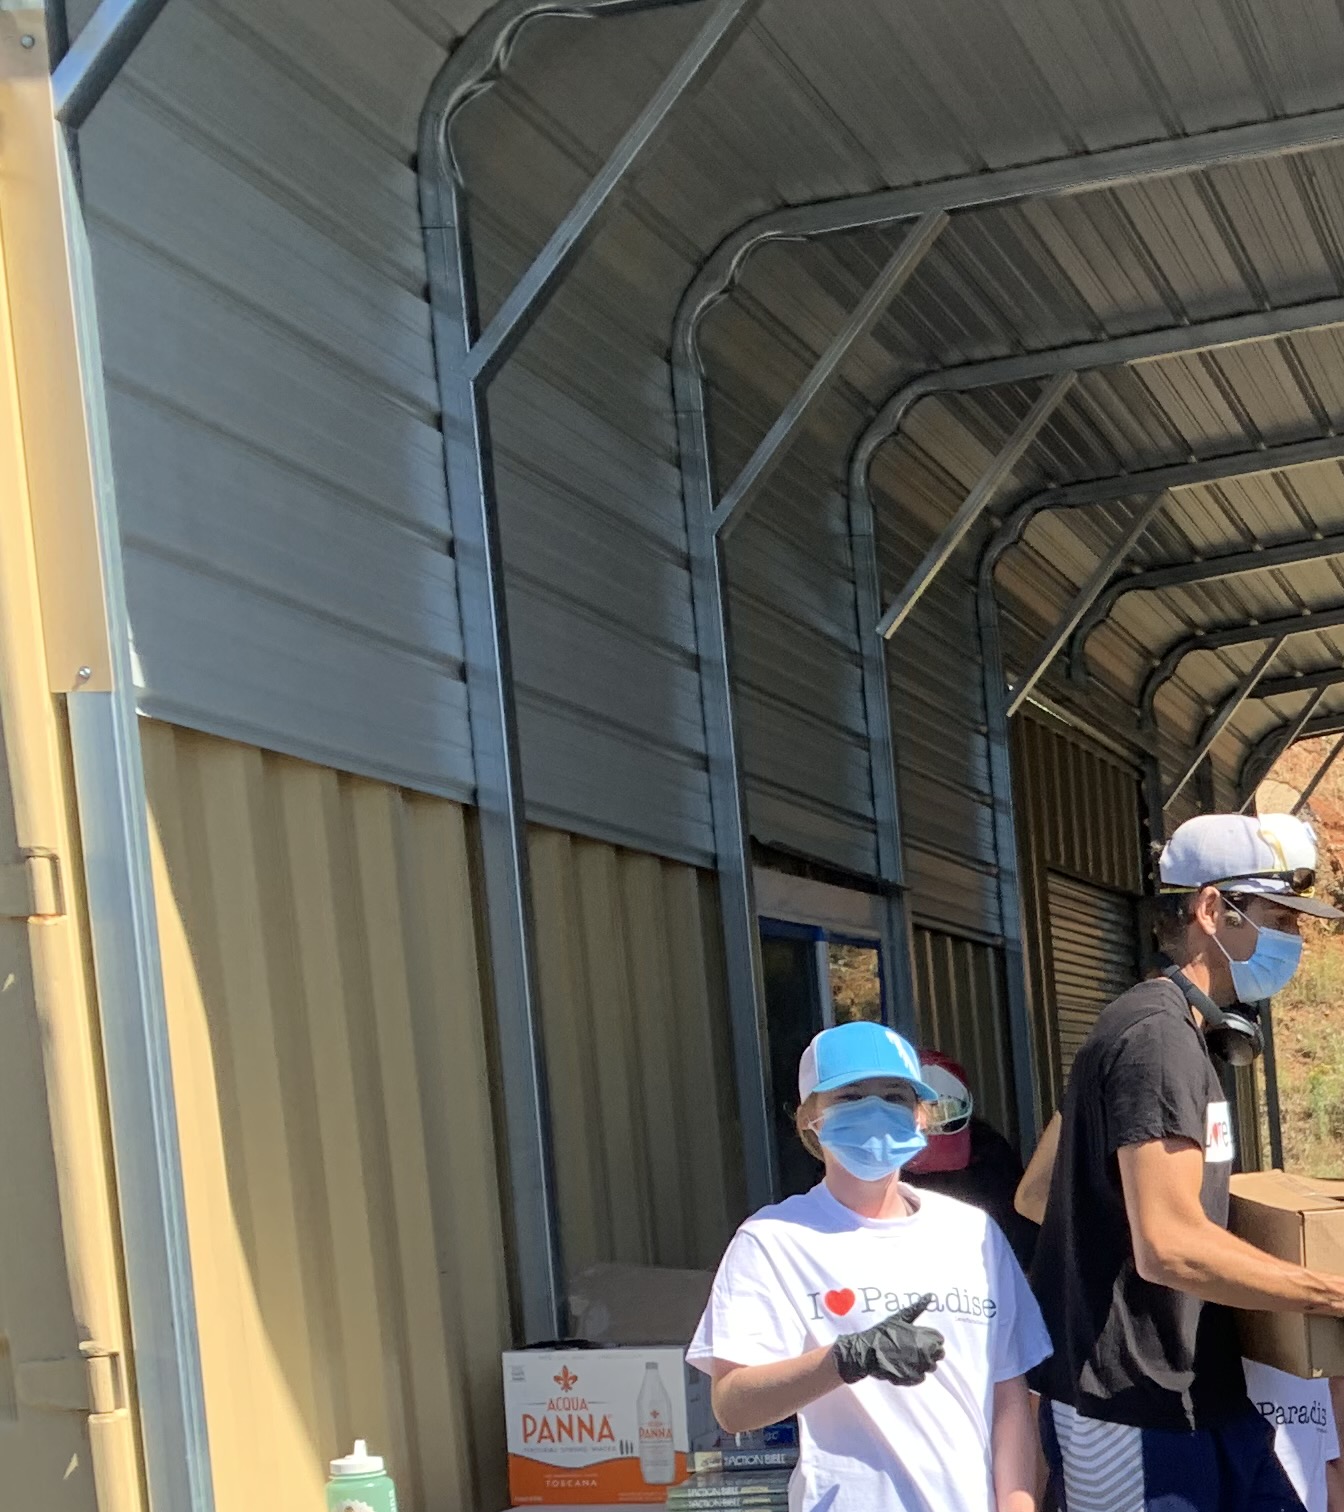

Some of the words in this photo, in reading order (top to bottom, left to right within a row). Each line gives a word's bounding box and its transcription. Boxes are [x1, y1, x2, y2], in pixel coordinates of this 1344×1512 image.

[807, 1292, 825, 1320] I
[858, 1287, 997, 1319] Paradise
[547, 1397, 589, 1412] ACQUA
[522, 1413, 615, 1444] PANNA
[639, 1427, 673, 1440] PANNA
[728, 1454, 763, 1466] ACTION
[545, 1479, 598, 1487] TOSCANA
